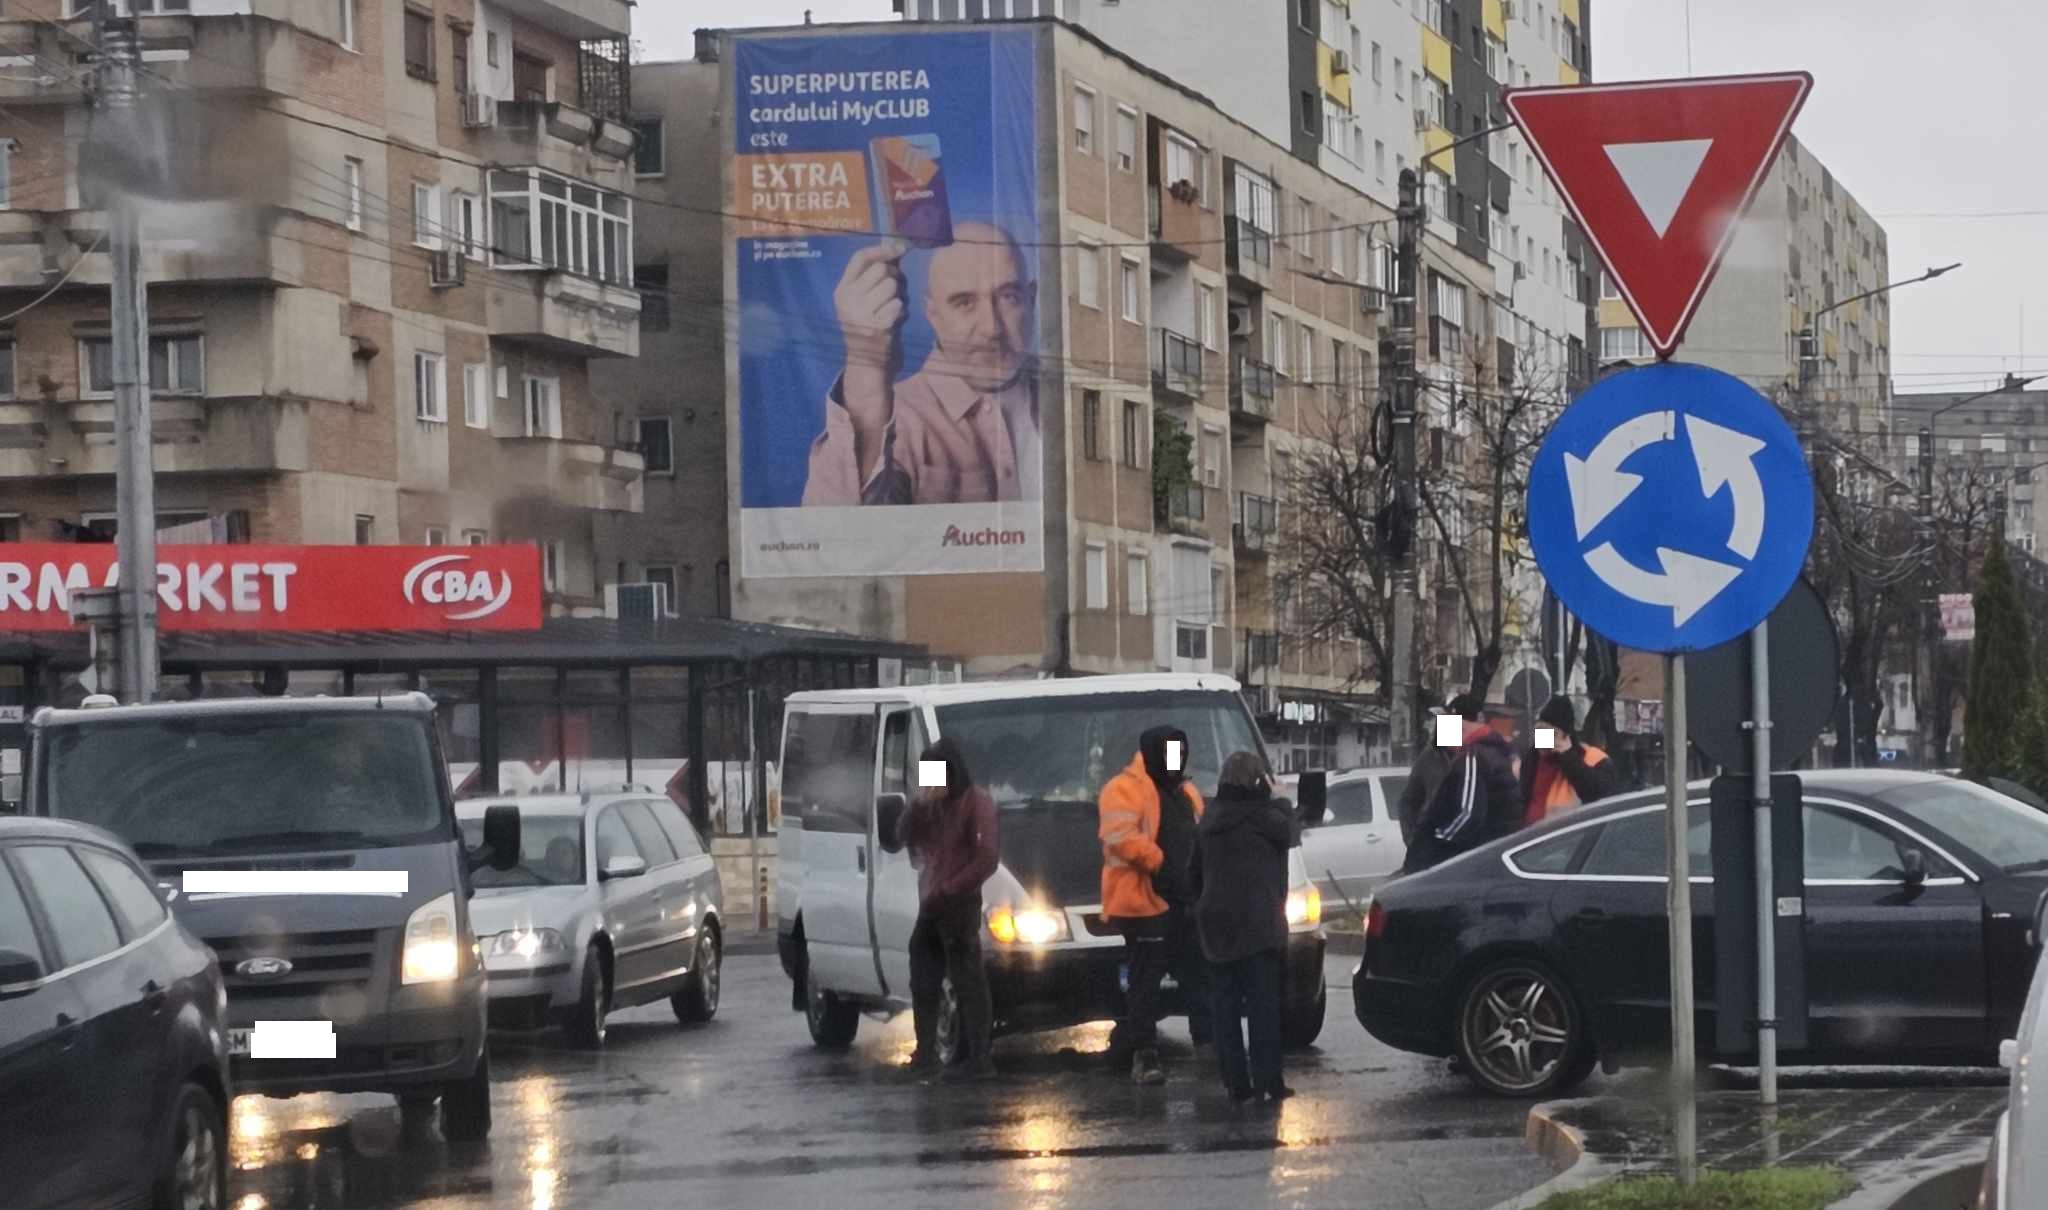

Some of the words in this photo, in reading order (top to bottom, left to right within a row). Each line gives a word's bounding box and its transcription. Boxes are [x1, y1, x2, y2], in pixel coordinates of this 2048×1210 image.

[750, 69, 930, 95] SUPERPUTEREA
[750, 101, 837, 122] cardului
[843, 98, 930, 125] MyCLUB
[750, 130, 789, 146] este
[752, 160, 848, 188] EXTRA
[752, 190, 850, 211] PUTEREA
[941, 524, 1026, 547] Auchan
[0, 562, 298, 612] RMRKET
[421, 570, 494, 603] CBA
